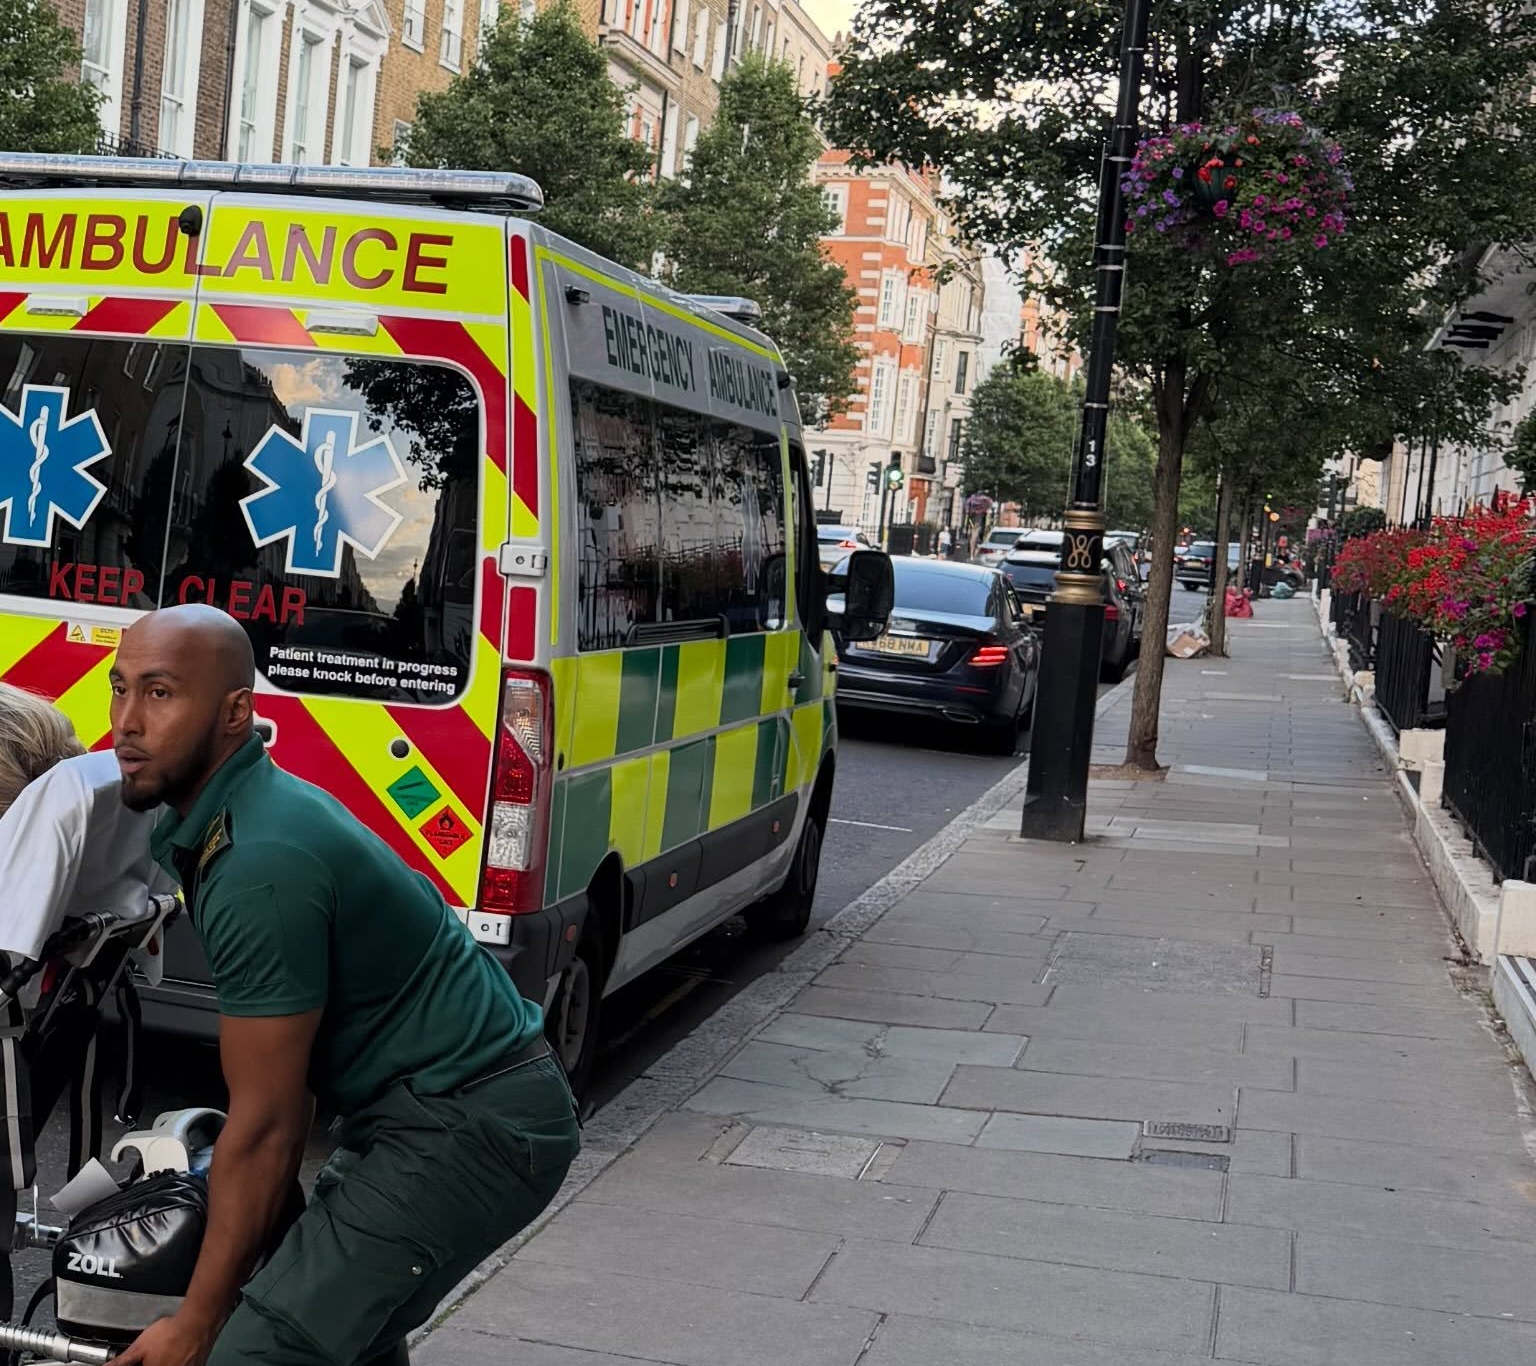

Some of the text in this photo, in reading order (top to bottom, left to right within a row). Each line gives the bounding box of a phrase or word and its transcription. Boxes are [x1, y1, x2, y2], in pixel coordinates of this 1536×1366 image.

[602, 304, 777, 417] EMERGENCY AMBULANCE
[49, 561, 145, 605] KEEP
[270, 646, 458, 676] Patient treatment in progress
[268, 664, 456, 695] please knock before entering
[67, 1251, 121, 1278] ZOLL
